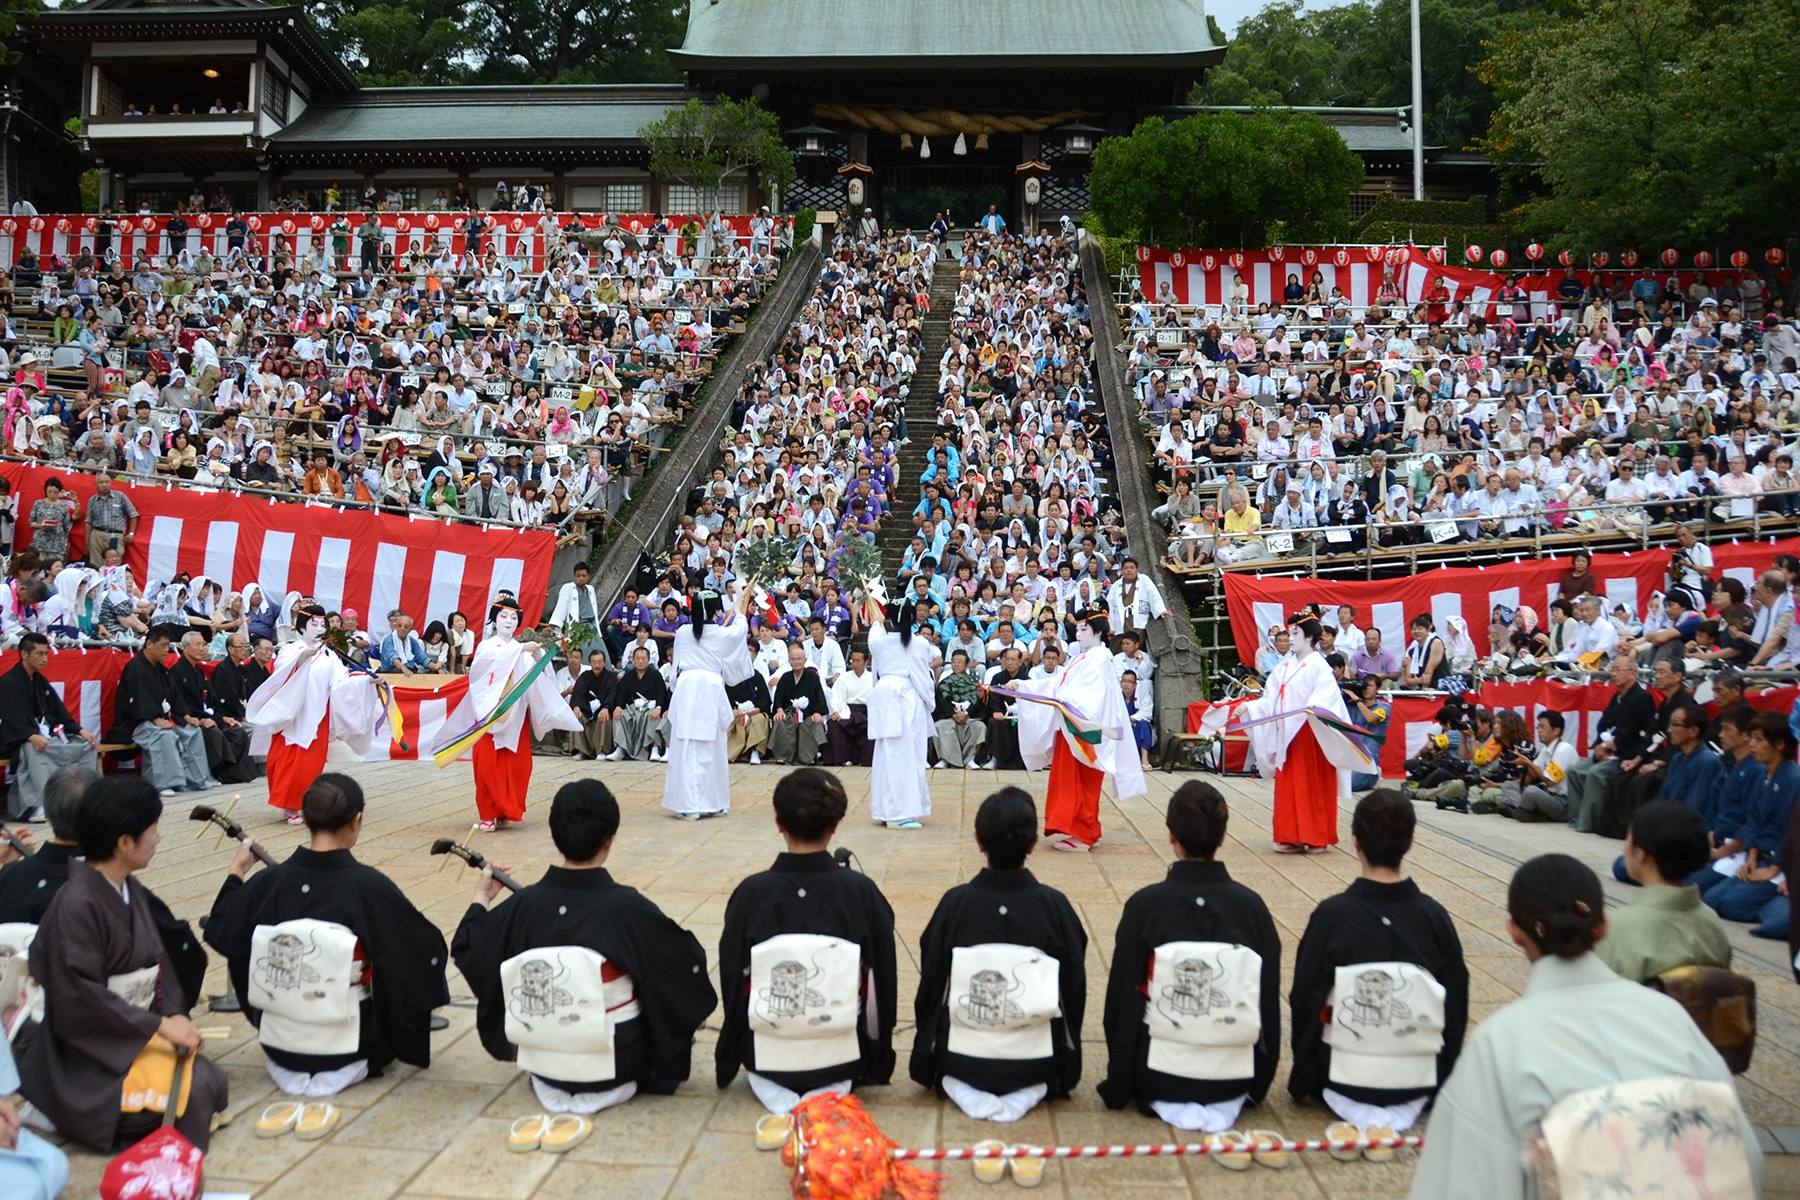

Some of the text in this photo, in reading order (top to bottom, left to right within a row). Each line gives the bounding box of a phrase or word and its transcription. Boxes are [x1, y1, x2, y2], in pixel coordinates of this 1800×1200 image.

[384, 301, 393, 309] Q-
[1159, 334, 1172, 342] R-1
[1285, 332, 1298, 340] R-3
[33, 350, 49, 358] M-9
[1173, 372, 1182, 380] P-
[487, 384, 504, 393] M-3
[554, 390, 570, 399] M-2
[402, 435, 418, 444] K-3
[486, 445, 504, 455] K-2
[549, 446, 564, 455] L-1
[1256, 467, 1267, 477] L-
[1433, 525, 1456, 538] K-4
[1269, 539, 1291, 551] K-2
